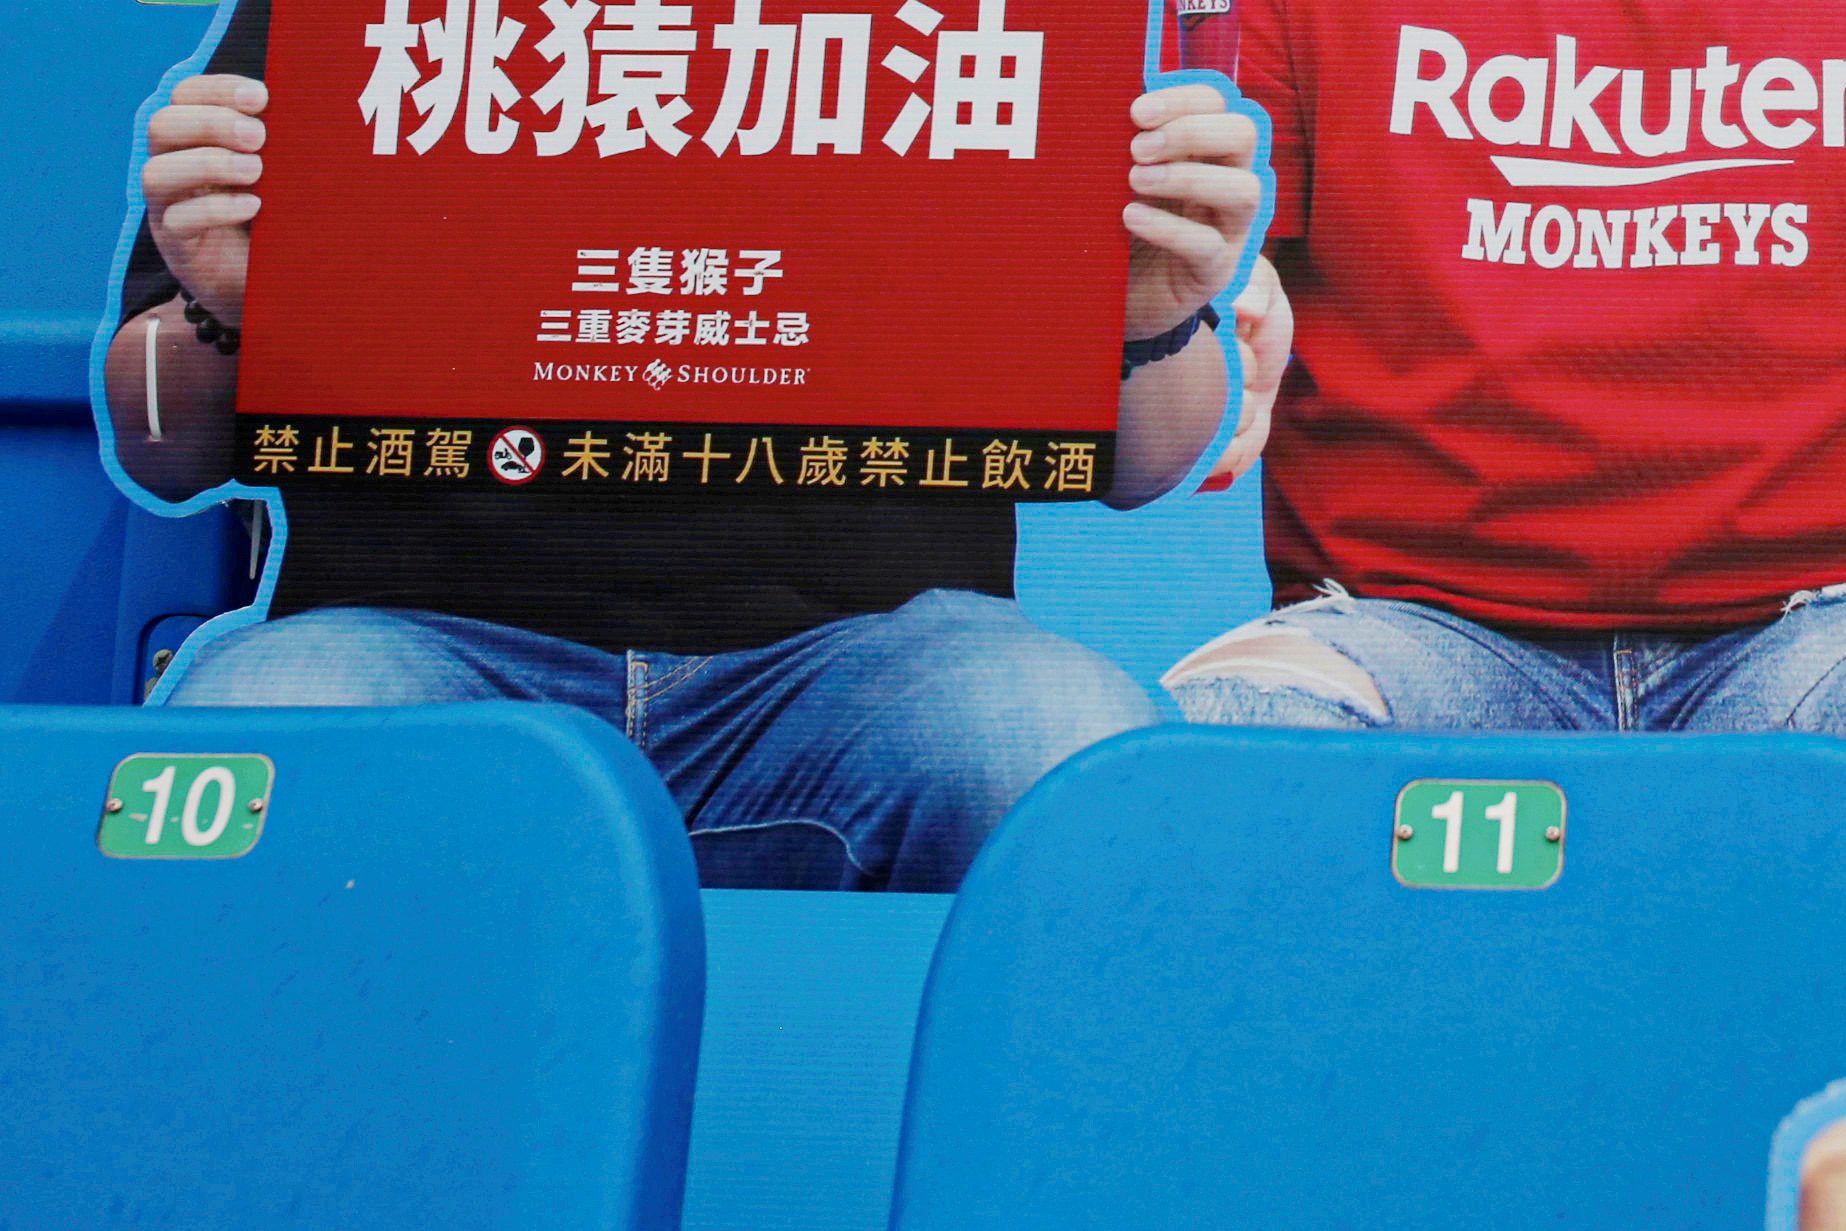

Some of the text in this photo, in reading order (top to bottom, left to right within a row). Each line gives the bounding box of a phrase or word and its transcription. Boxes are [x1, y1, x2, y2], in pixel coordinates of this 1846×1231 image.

[1461, 198, 1809, 269] MONKEYS
[571, 246, 785, 298] 三隻猴子
[536, 308, 811, 348] 三重麥芽威士忌
[533, 362, 807, 385] MONKEY SHOULDER
[253, 424, 1098, 493] 禁止酒駕 未滿十八歲禁止飲酒
[142, 766, 236, 847] 10
[1431, 791, 1518, 874] 11
